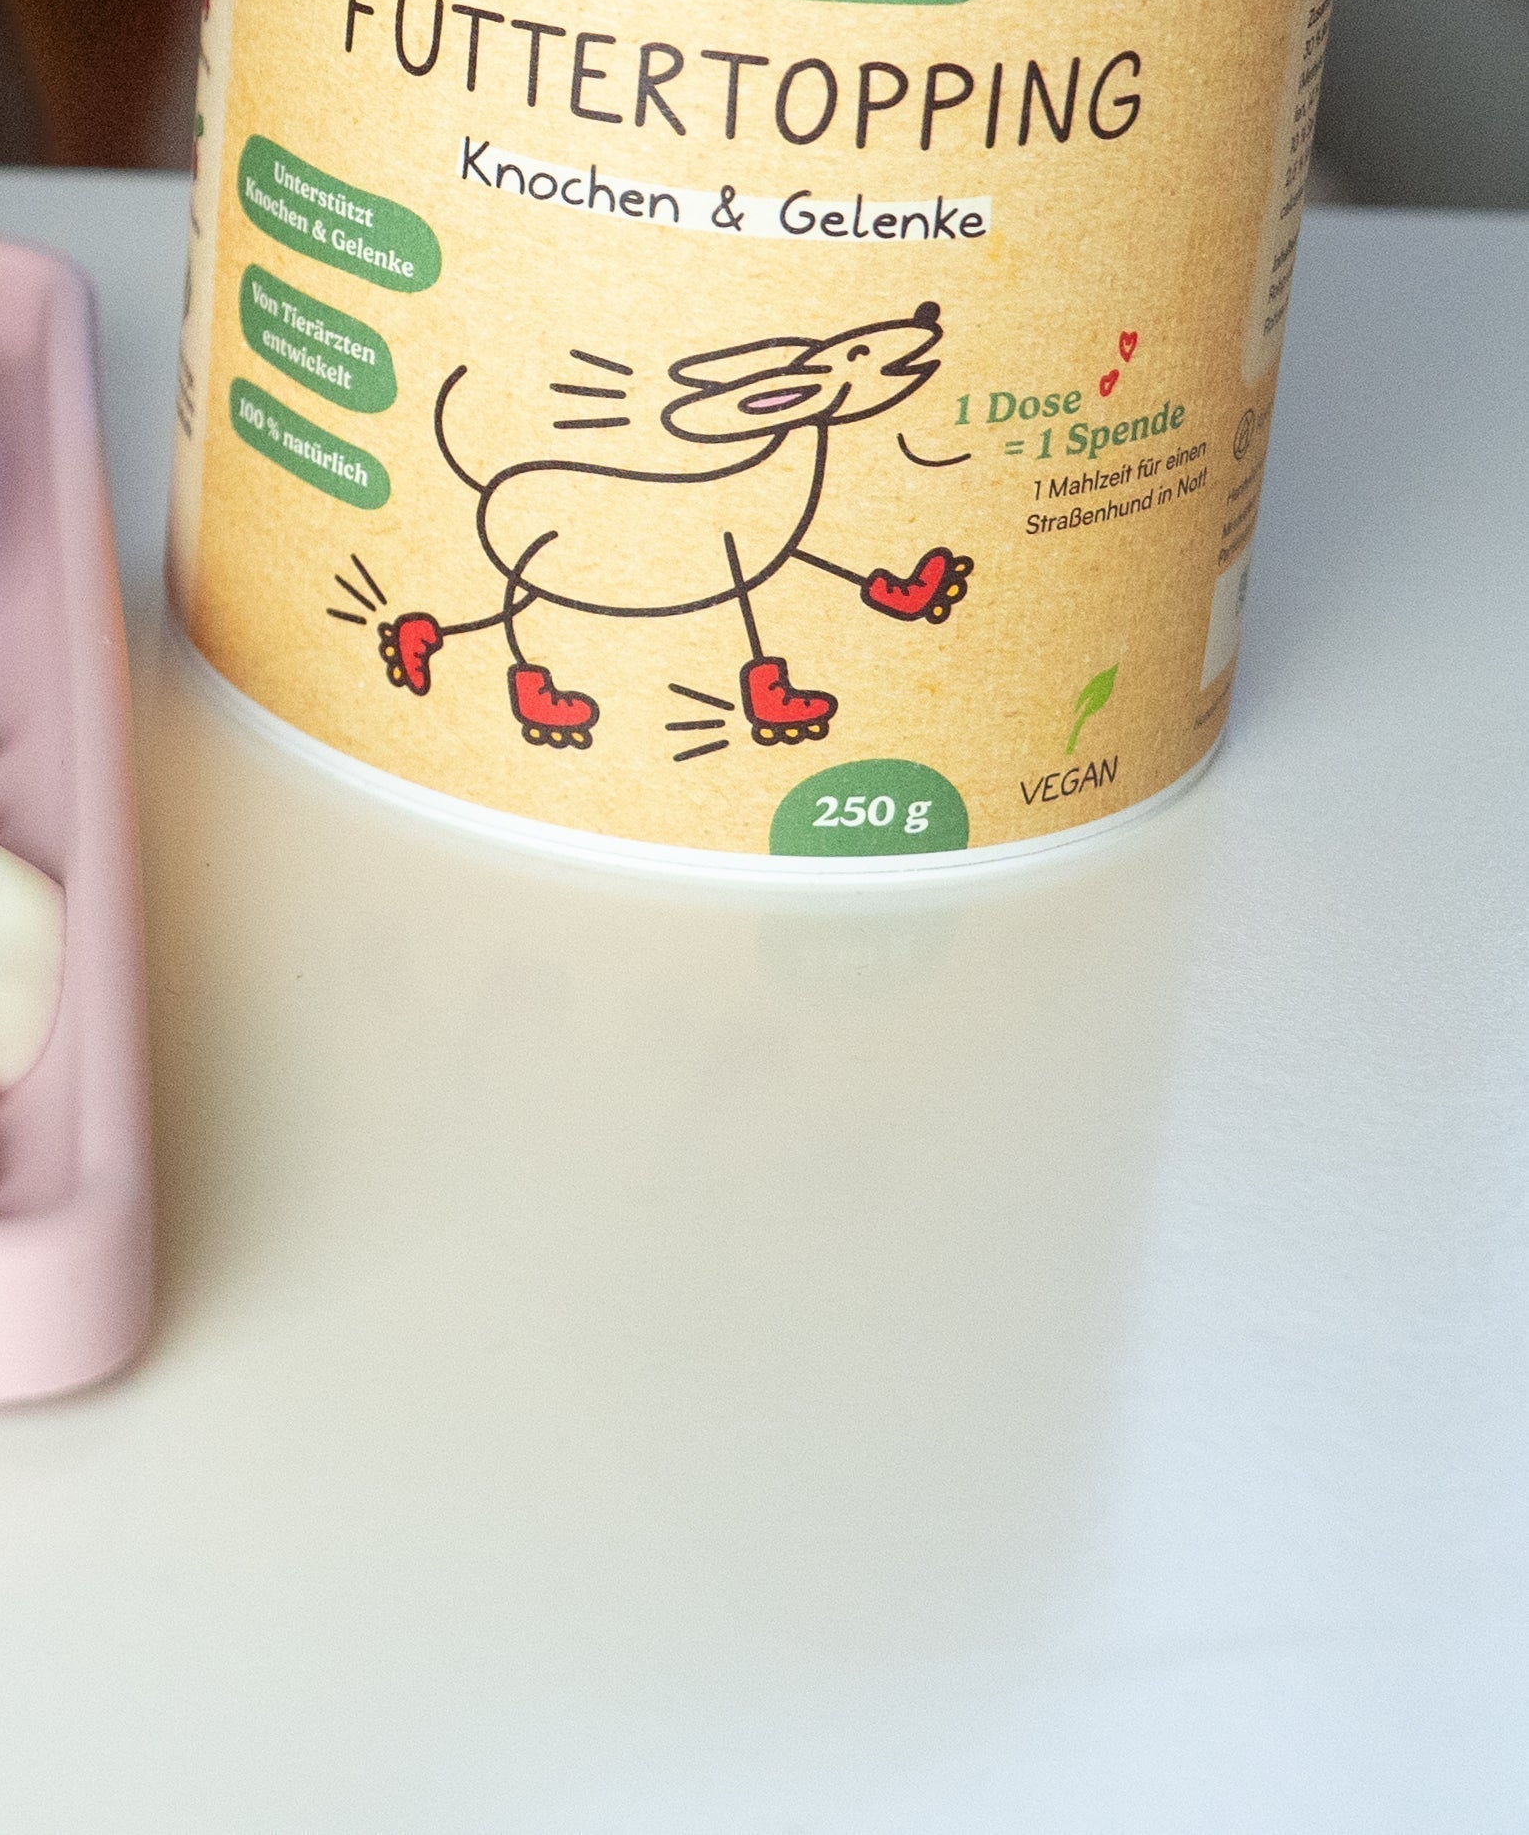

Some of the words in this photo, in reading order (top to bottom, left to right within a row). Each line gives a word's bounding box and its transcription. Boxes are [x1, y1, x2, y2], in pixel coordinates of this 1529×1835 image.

[273, 161, 374, 228] Unterstützt
[461, 135, 680, 223] Knochen
[711, 184, 744, 232] &
[780, 188, 987, 240] Gelenke
[245, 177, 309, 234] Knochen
[312, 220, 327, 243] &
[332, 229, 415, 278] Gelenke
[252, 281, 279, 316] Von
[281, 301, 376, 365] Tierärzten
[262, 329, 352, 390] entwickelt
[954, 394, 970, 425] 1
[986, 390, 1082, 424] Dose
[1004, 440, 1025, 455] =
[1037, 428, 1053, 460] 1
[1066, 400, 1186, 460] Spende
[240, 397, 265, 430] 100
[267, 417, 280, 441] %
[283, 431, 368, 487] natürlich
[1034, 480, 1042, 501] 1
[1048, 464, 1132, 499] Mahlzeit
[1137, 459, 1162, 480] für
[1165, 441, 1207, 471] einen
[1025, 489, 1154, 535] Straßenhund
[1158, 485, 1172, 505] in
[1176, 467, 1208, 499] Not!
[1020, 755, 1119, 806] VEGAN
[812, 795, 896, 827] 250
[904, 798, 932, 833] g
